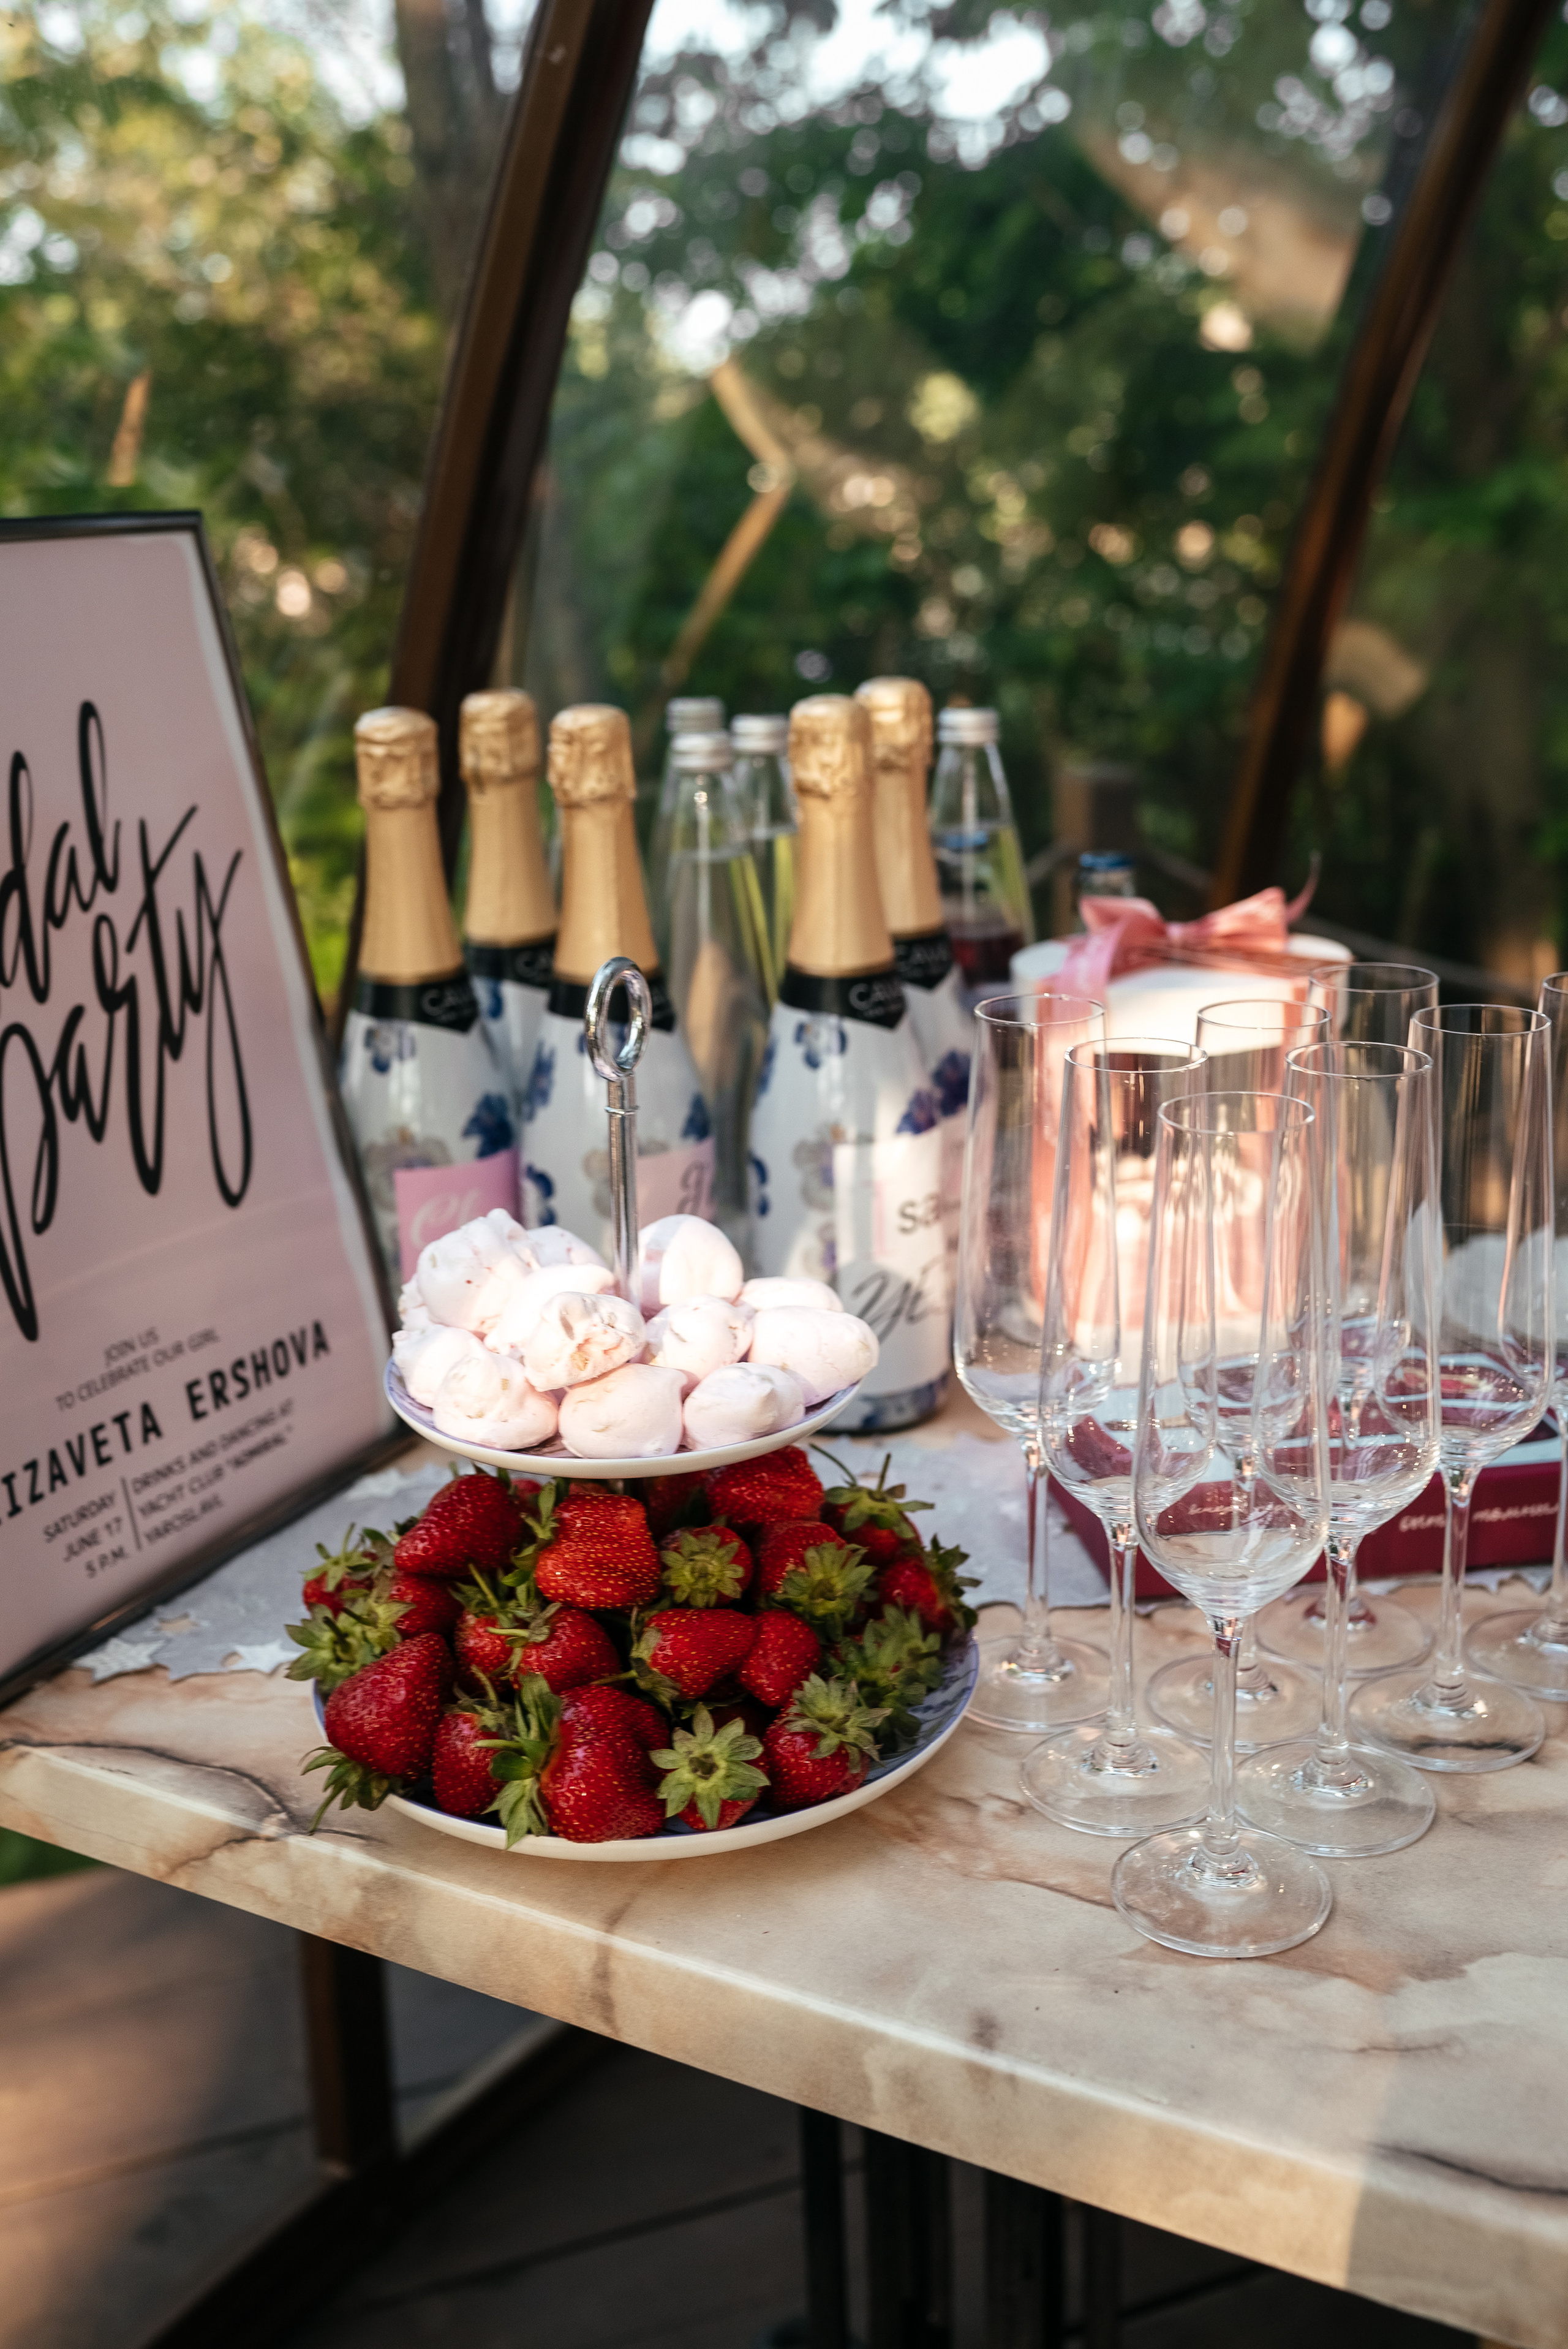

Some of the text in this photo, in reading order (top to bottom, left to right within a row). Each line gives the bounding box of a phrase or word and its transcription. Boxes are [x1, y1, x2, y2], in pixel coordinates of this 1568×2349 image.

[0, 805, 252, 1342] party
[104, 1326, 159, 1367] JOIN US
[56, 1391, 75, 1410] TO
[77, 1355, 149, 1402] CELEBRATE
[153, 1340, 184, 1367] OUR
[0, 1319, 331, 1526] IZAVETA ERSHOVA
[132, 1455, 185, 1495] DRINKS
[189, 1442, 217, 1465] AND
[138, 1484, 184, 1519] YACHT
[188, 1463, 224, 1495] CLUB
[43, 1491, 115, 1543] SATURDAY
[64, 1516, 122, 1562] JUNE 17
